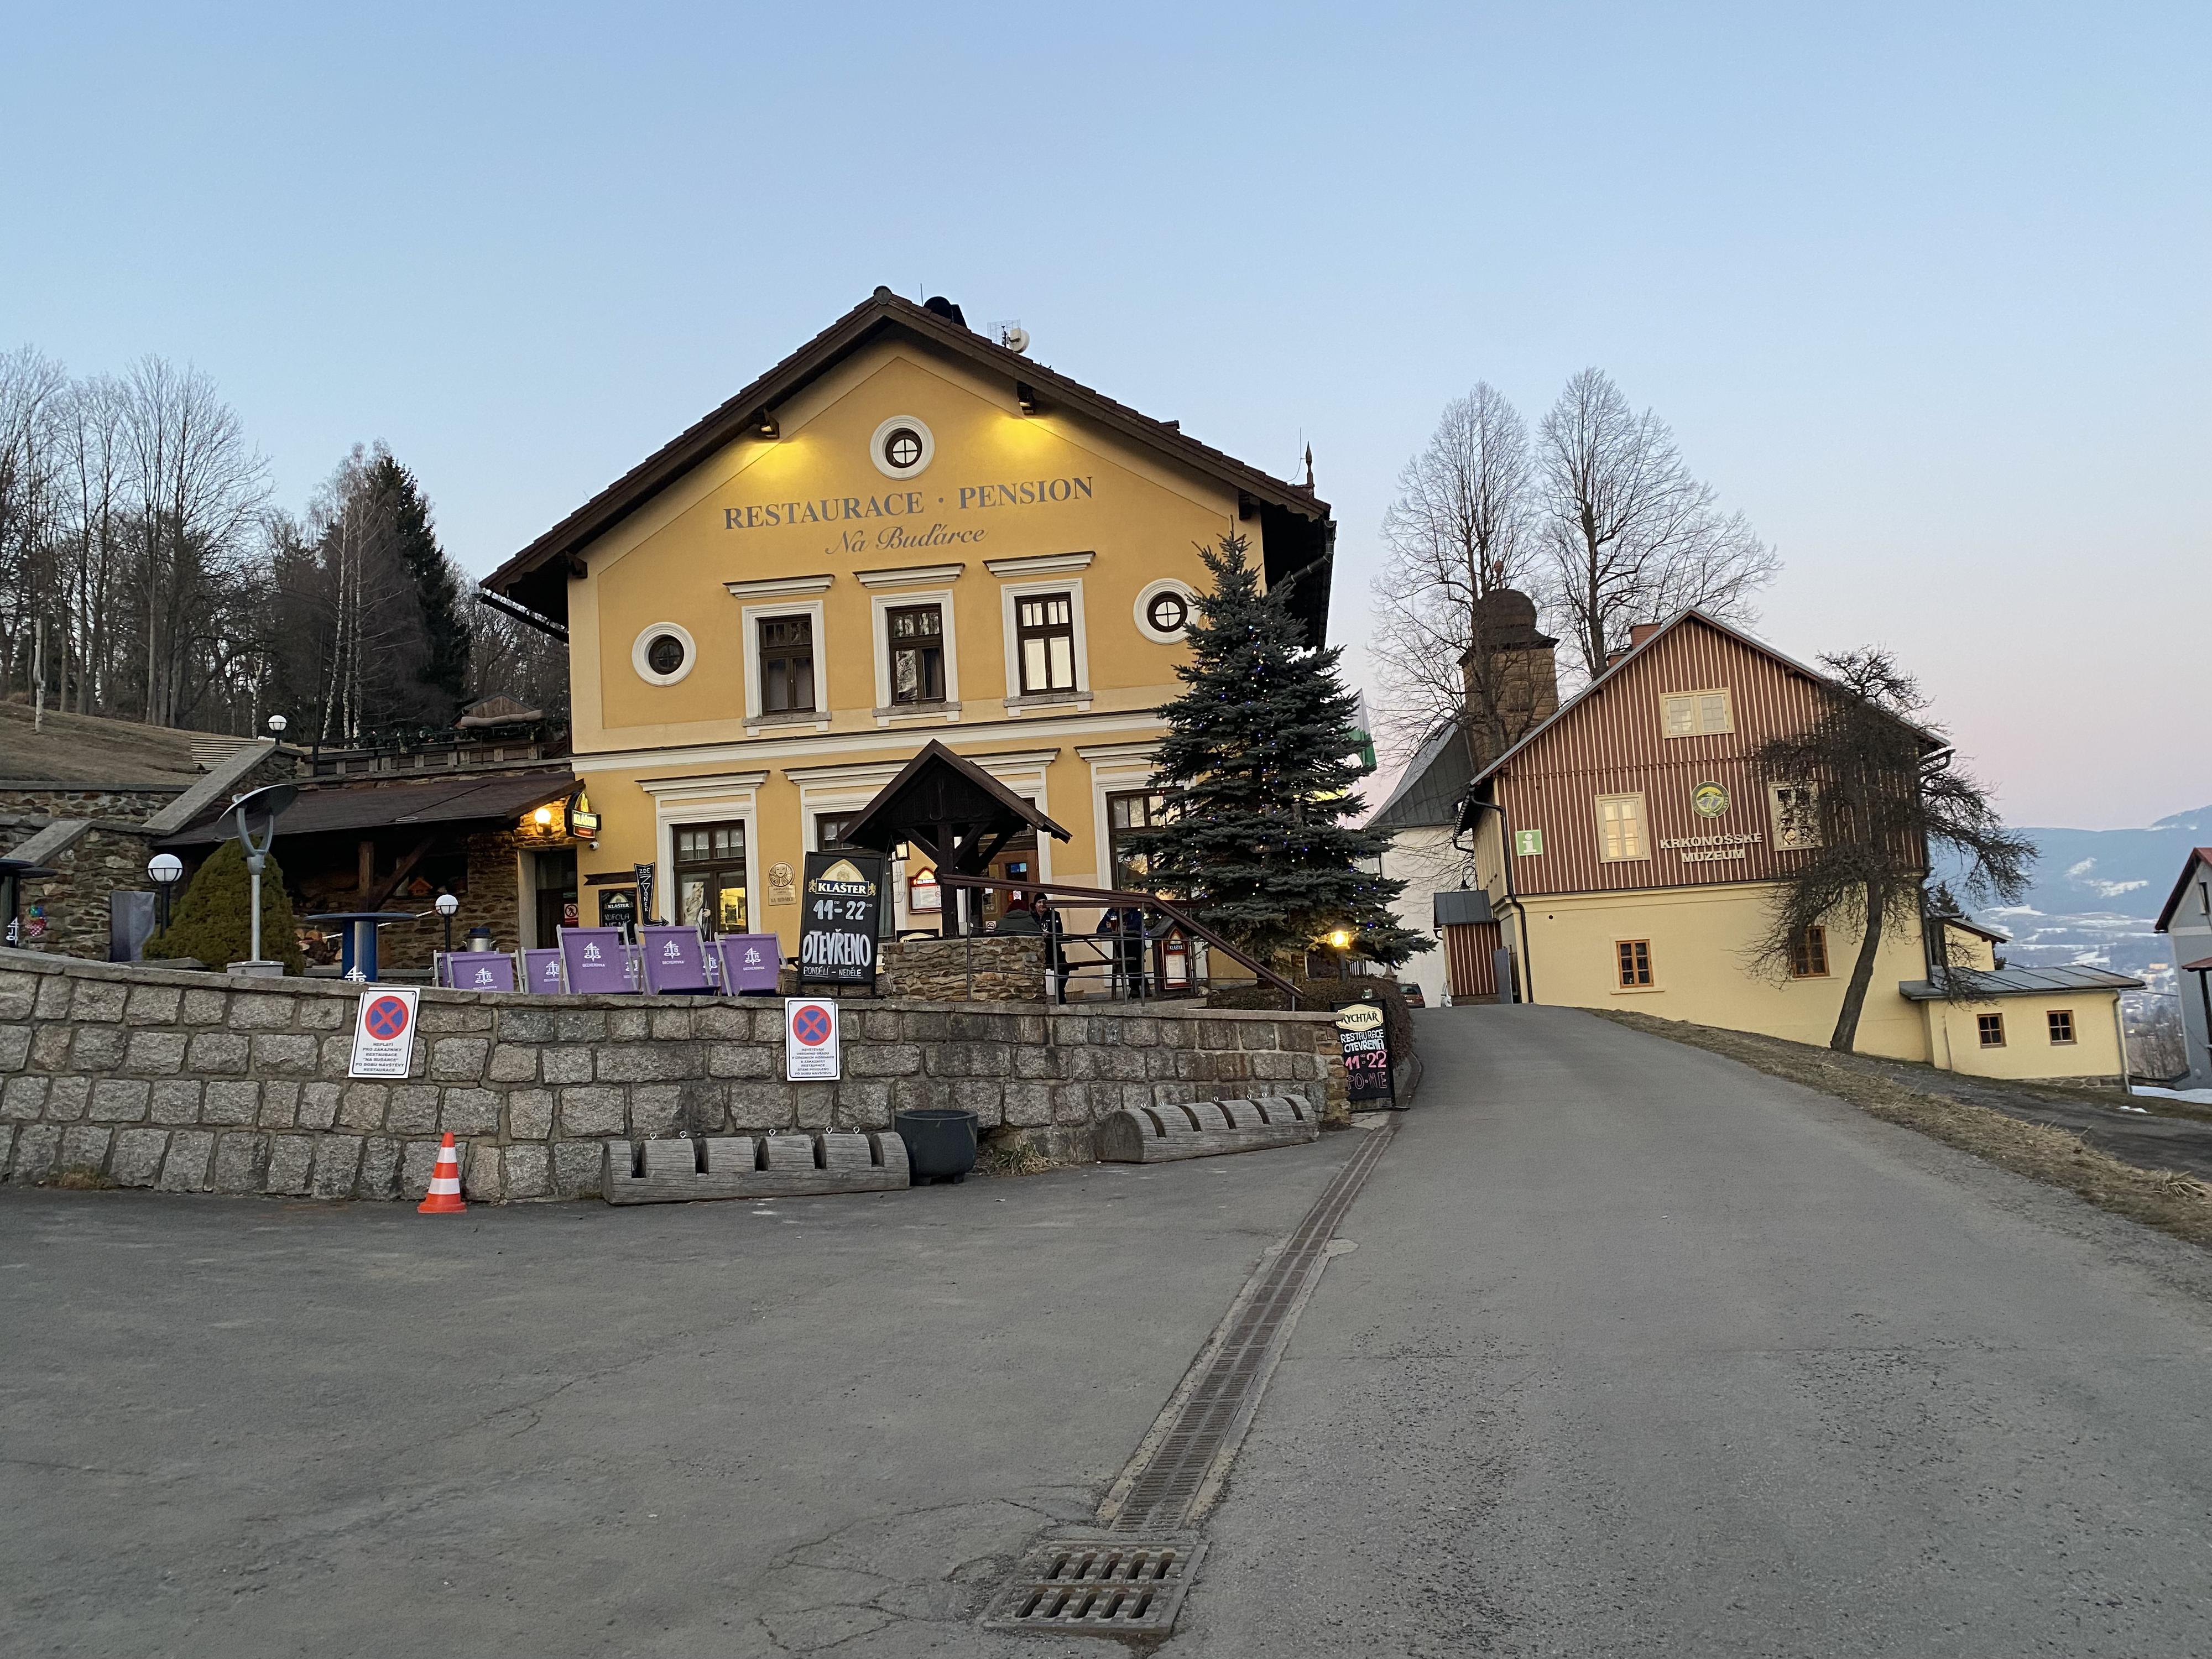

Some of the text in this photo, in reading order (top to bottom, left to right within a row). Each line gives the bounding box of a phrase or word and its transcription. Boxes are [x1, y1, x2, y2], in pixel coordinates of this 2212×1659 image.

[723, 492, 925, 530] RESTAURACE
[958, 477, 1093, 509] PENSION
[825, 523, 988, 555] Na Buďárce
[1681, 848, 1745, 863] MUZEUM
[640, 875, 651, 912] ZVONEK
[818, 882, 867, 894] KLÁŠTER
[802, 928, 872, 967] OTEVŘENO
[1340, 1029, 1384, 1044] RESTAURACE
